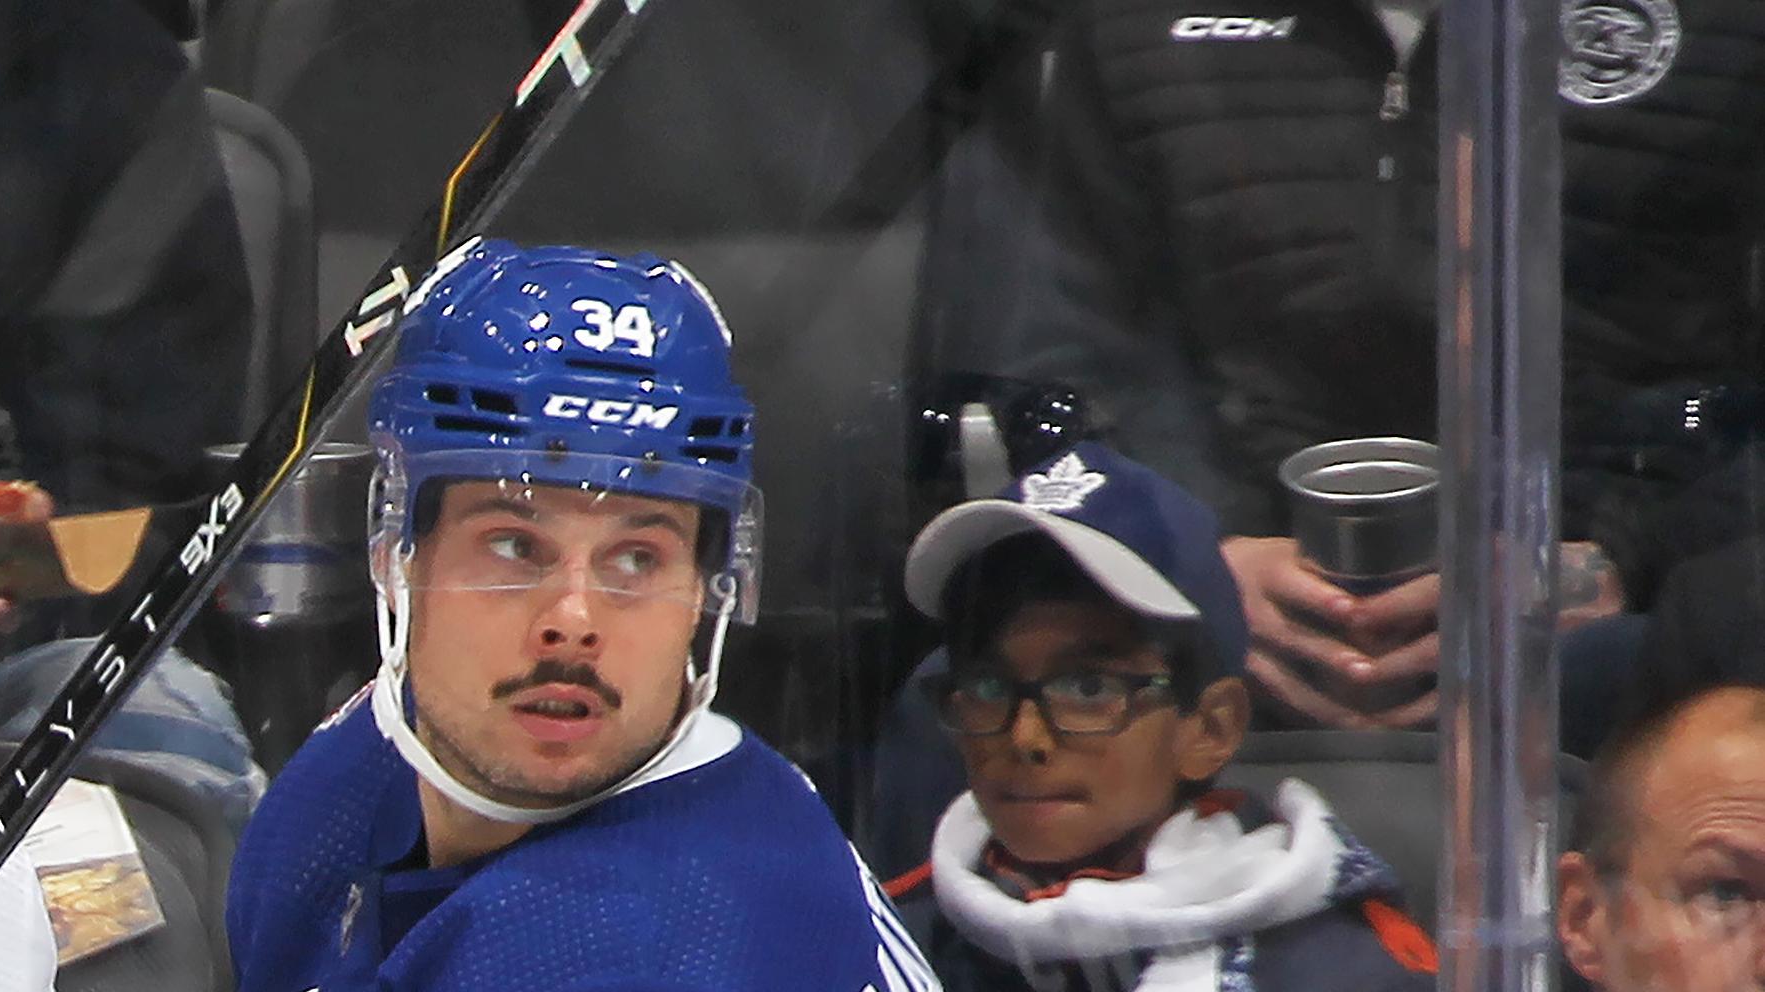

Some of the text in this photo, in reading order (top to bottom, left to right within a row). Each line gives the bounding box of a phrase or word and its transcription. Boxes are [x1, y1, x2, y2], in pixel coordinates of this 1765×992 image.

[570, 298, 656, 358] 34
[542, 394, 679, 430] CCM
[179, 481, 245, 575] 9X3
